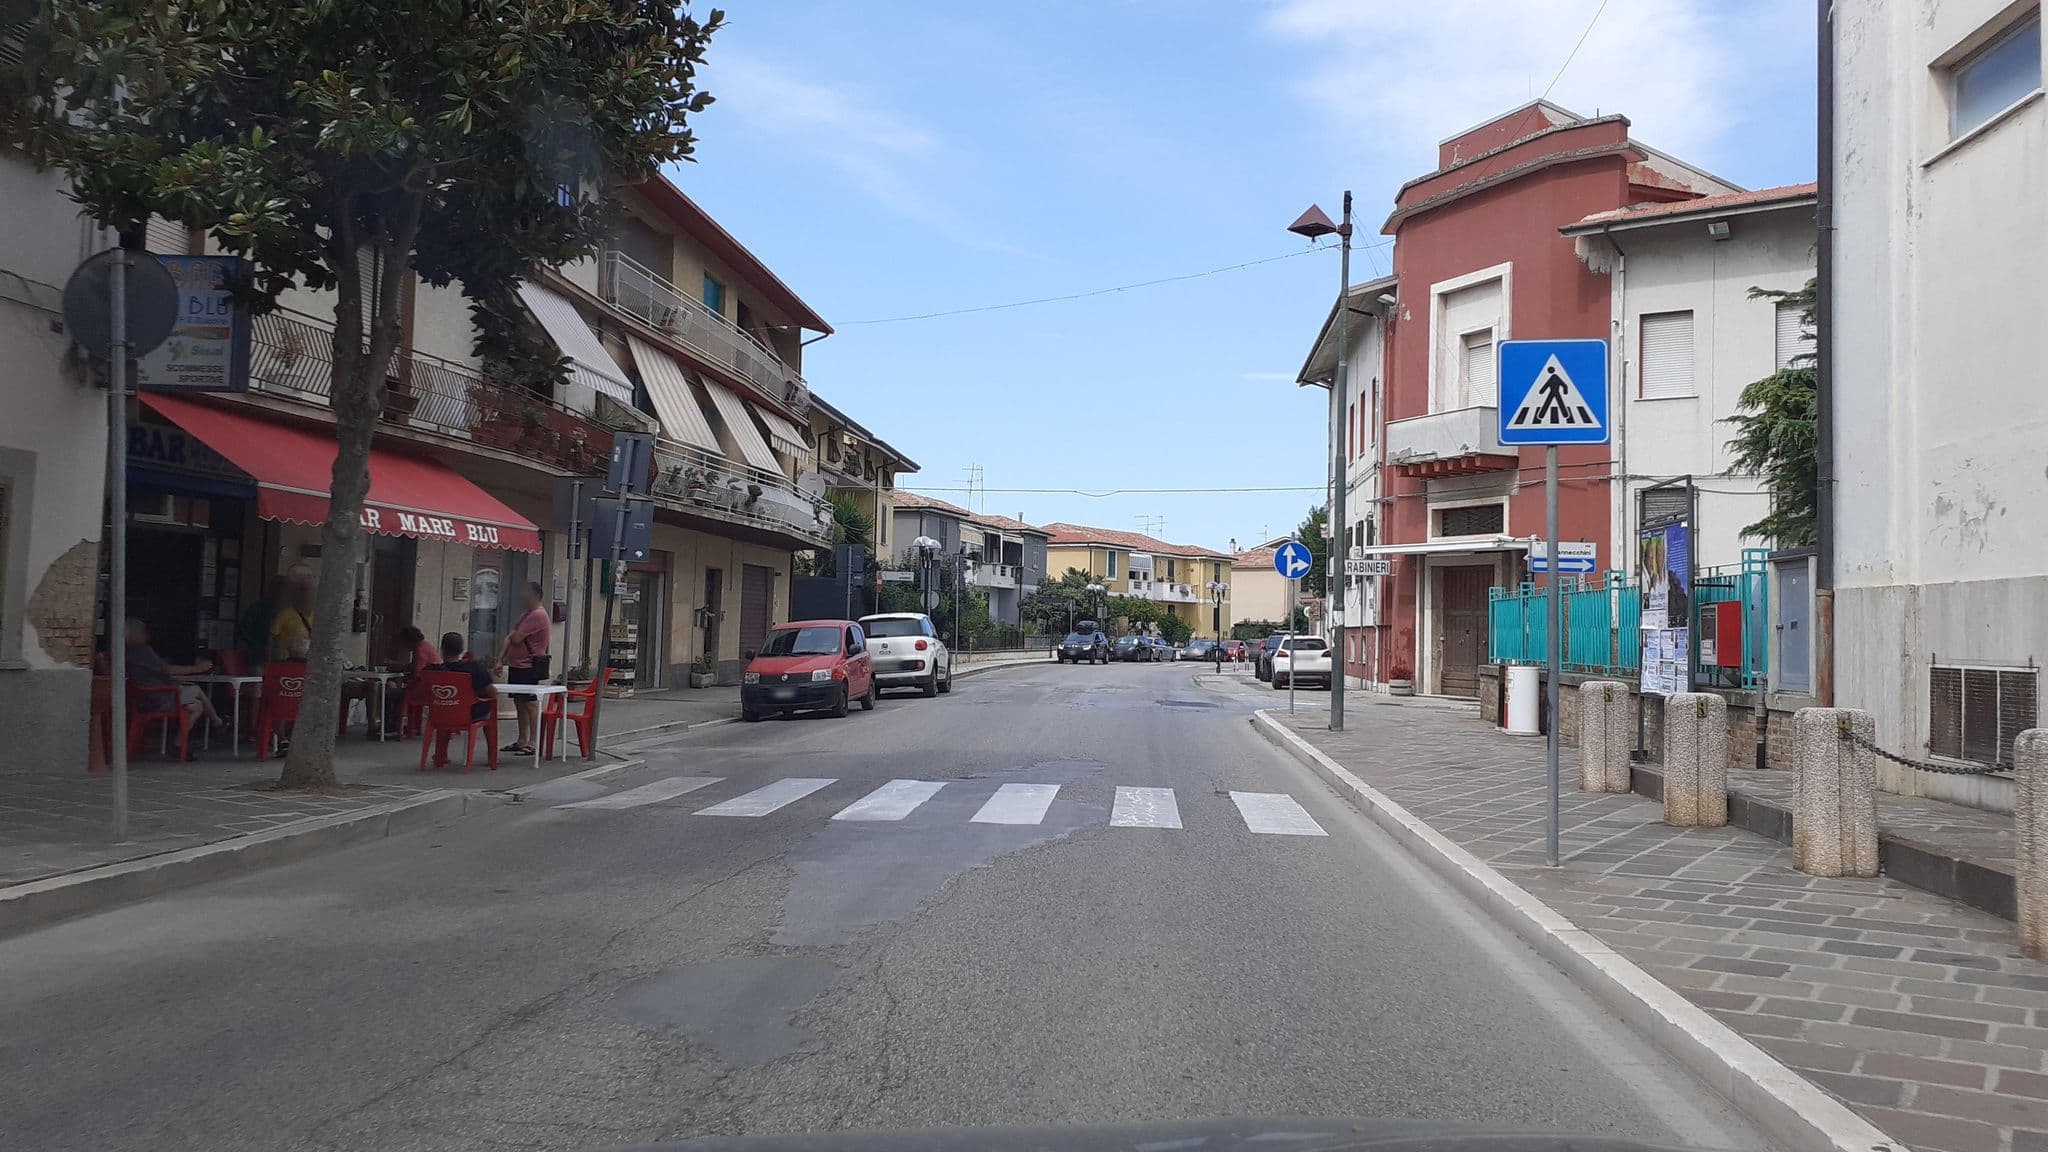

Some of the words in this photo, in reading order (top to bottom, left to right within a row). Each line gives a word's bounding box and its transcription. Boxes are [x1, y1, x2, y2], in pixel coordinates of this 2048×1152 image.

[166, 363, 225, 374] SCOMMESSE
[178, 374, 225, 384] SPORTIVE
[127, 425, 186, 465] BAR
[397, 512, 456, 537] MARE
[464, 523, 499, 544] BLU
[1345, 561, 1390, 573] RABINIERI
[279, 690, 303, 698] ALGID
